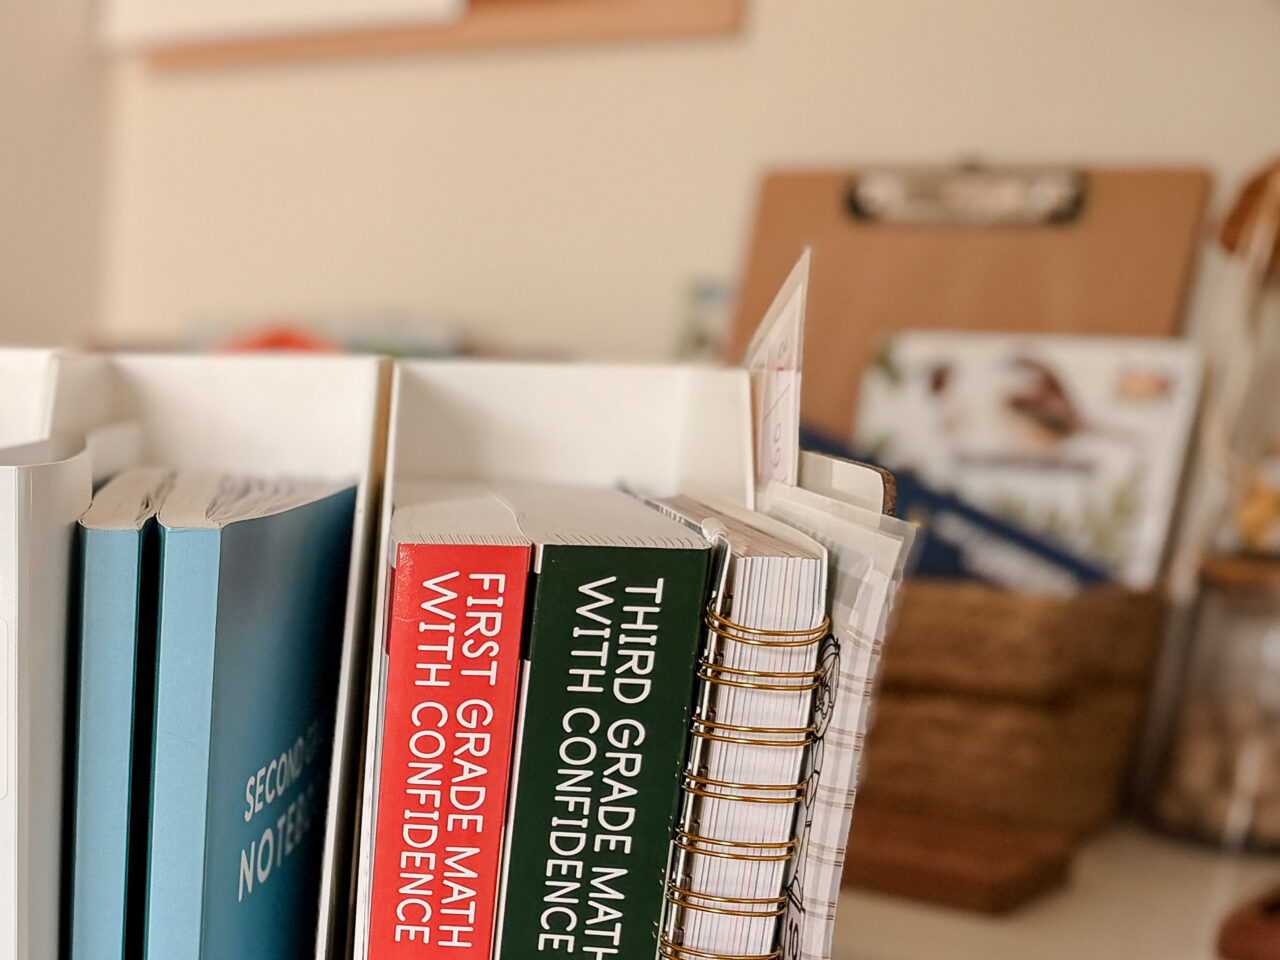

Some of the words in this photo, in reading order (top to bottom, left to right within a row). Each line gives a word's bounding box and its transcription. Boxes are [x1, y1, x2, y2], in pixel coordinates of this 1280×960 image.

[414, 570, 460, 687] WITH
[460, 573, 506, 686] FIRST
[566, 575, 617, 693] WITH
[613, 577, 664, 704] THIRD
[244, 736, 304, 822] SECOND
[394, 701, 449, 944] CONFIDENCE
[446, 698, 494, 833] GRADE
[593, 718, 646, 854] GRADE
[537, 707, 601, 953] CONFIDENCE
[437, 846, 481, 948] MATH
